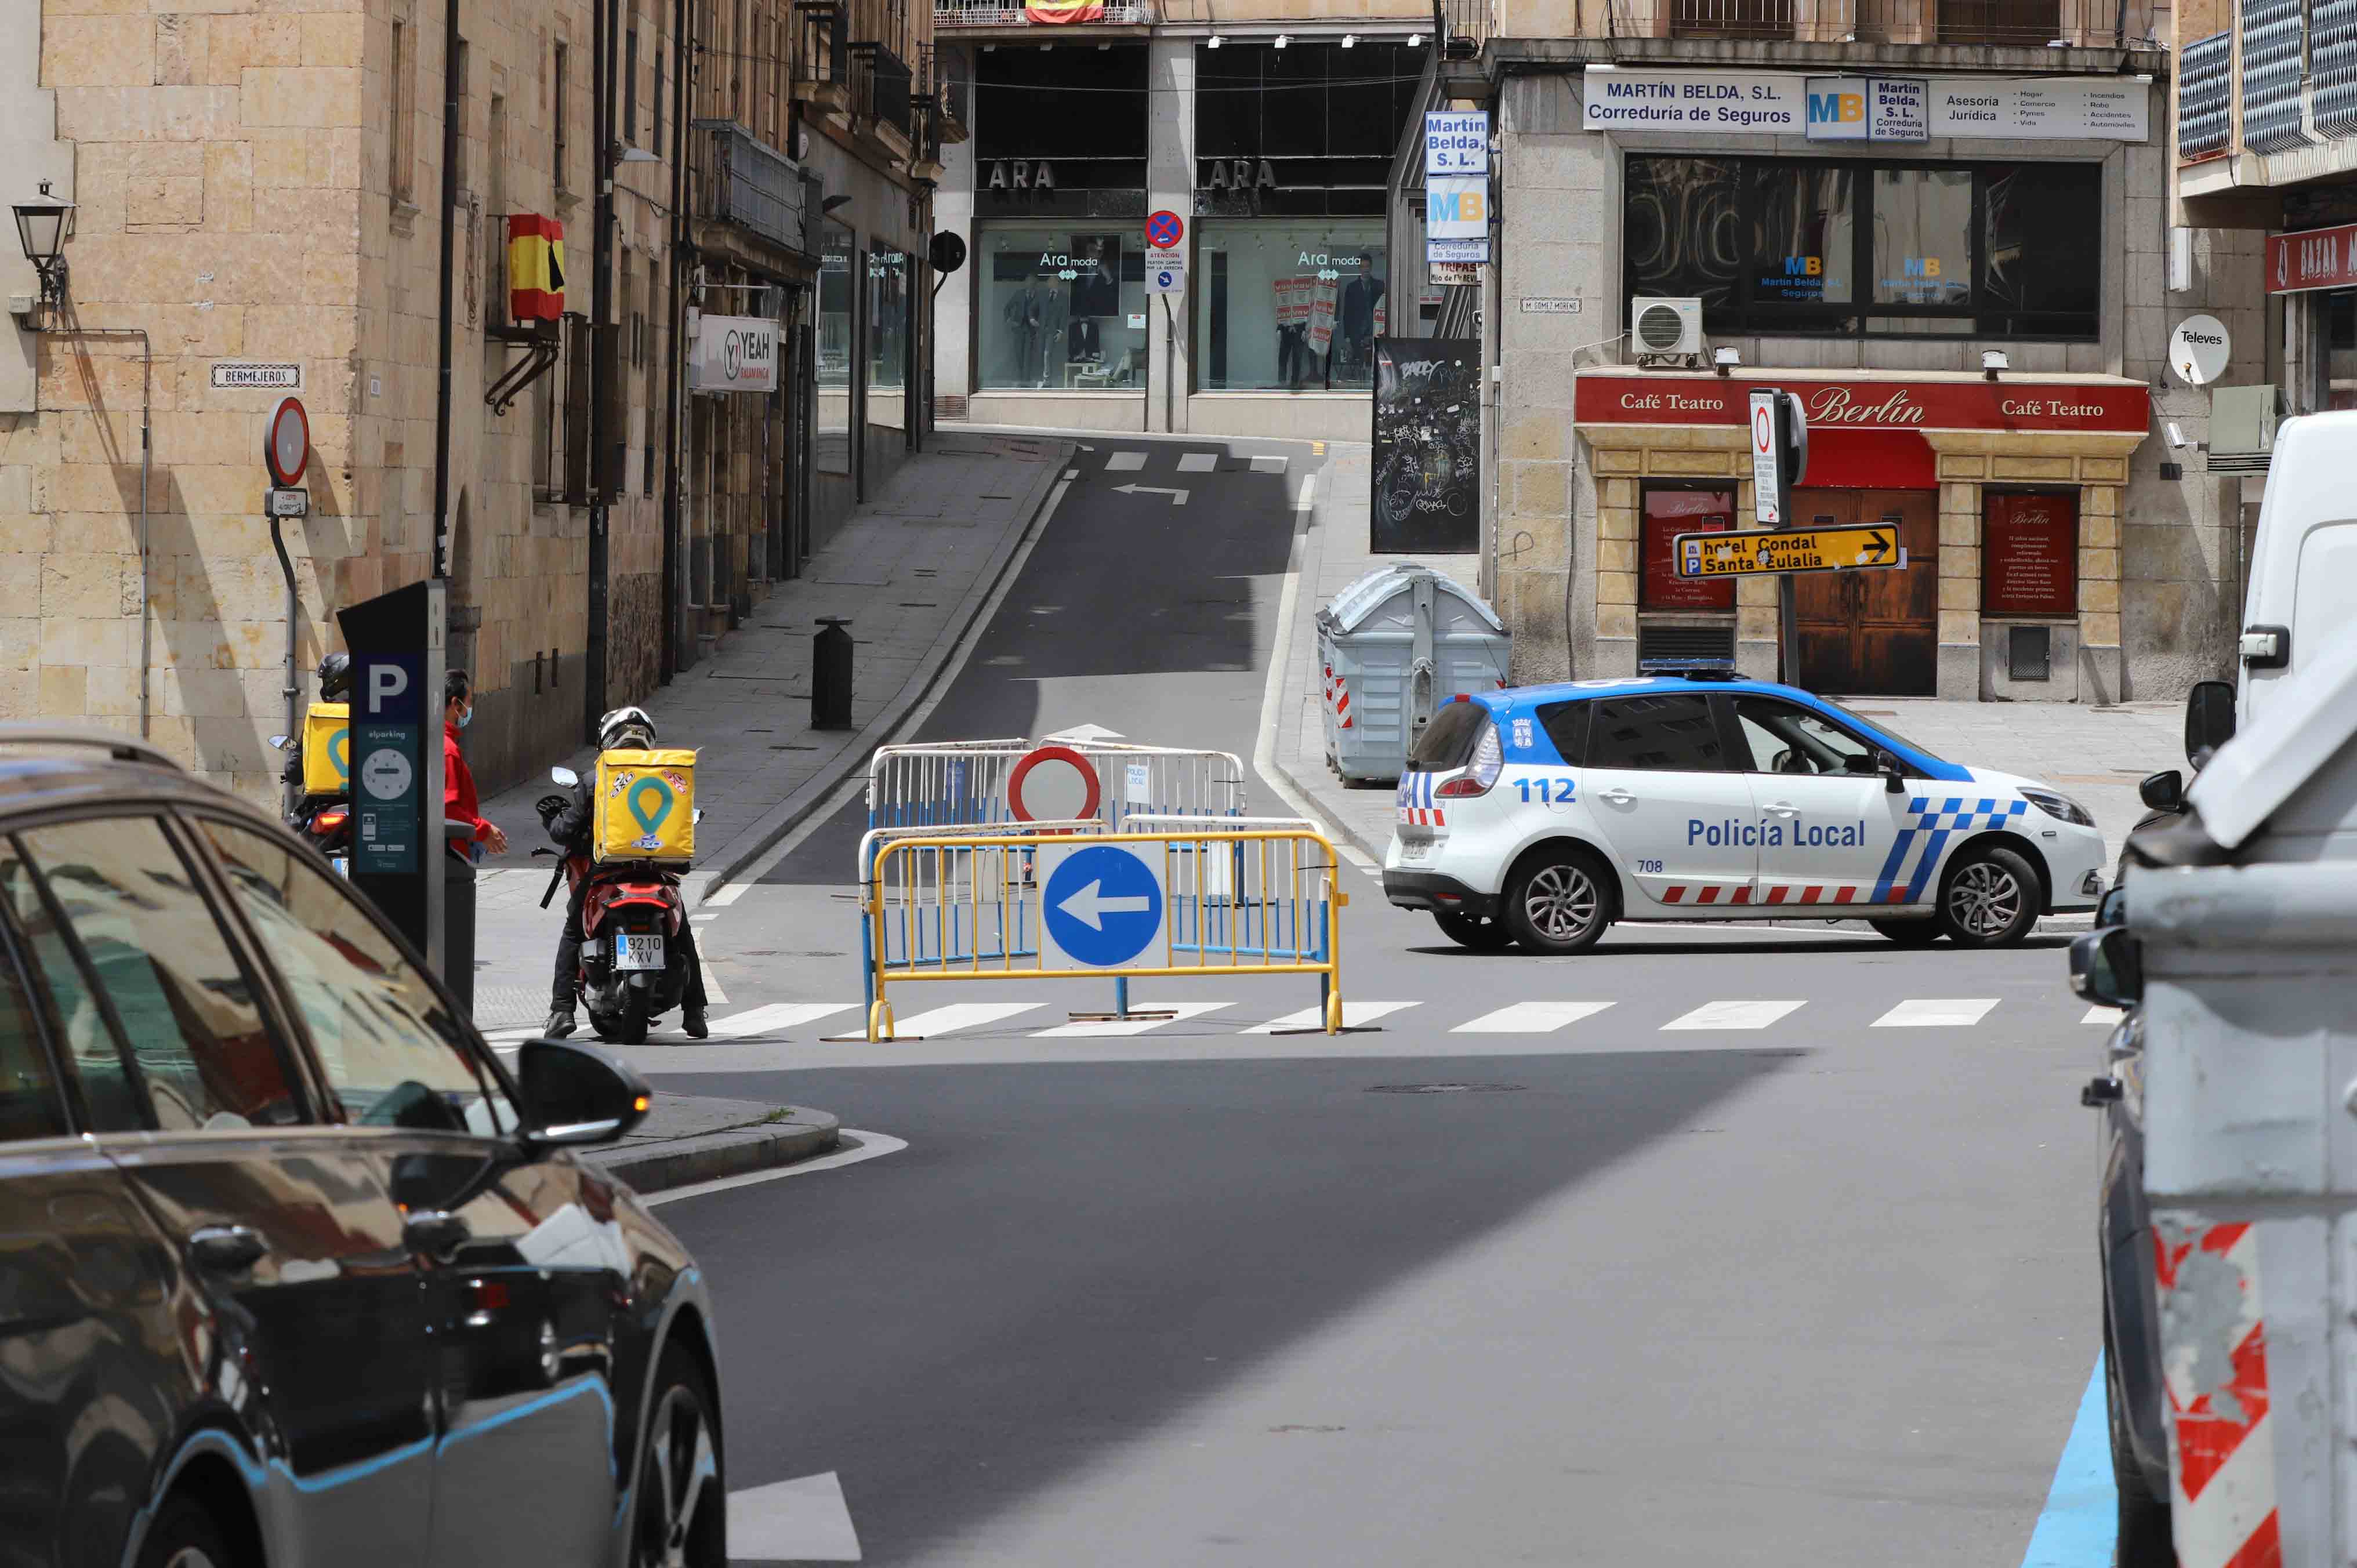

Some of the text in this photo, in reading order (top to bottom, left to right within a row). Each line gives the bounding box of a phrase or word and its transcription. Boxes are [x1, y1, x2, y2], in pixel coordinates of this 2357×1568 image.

[1607, 81, 1781, 102] MARTÍN BELDA, S.L.
[1878, 82, 1920, 94] Martín
[1808, 93, 1864, 123] MB
[1879, 95, 1920, 108] Belda,
[1946, 95, 1999, 107] Asesoría
[1589, 104, 1791, 125] Correduría de Seguros
[1885, 107, 1914, 118] S. L.
[1949, 110, 1997, 121] Jurídica
[1428, 118, 1486, 132] Martín
[1876, 119, 1923, 128] Correduría
[1888, 128, 1924, 138] Seguros
[1428, 136, 1485, 151] Belda,
[1437, 153, 1475, 166] S. L.
[988, 162, 1055, 188] ARA
[1209, 160, 1276, 188] ARA
[1430, 193, 1484, 222] MB
[1039, 252, 1098, 266] Ara moda
[1297, 251, 1361, 266] Ara moda
[1445, 251, 1481, 259] Seguros
[2301, 237, 2338, 280] BAZAR
[1785, 256, 1822, 275] MB
[1904, 257, 1940, 278] MB
[1554, 302, 1577, 310] MORENO
[2181, 331, 2222, 344] Televes
[741, 332, 770, 360] YEAH
[226, 371, 287, 382] BERMEJEROS
[1620, 393, 1724, 411] Café Teatro
[2001, 400, 2104, 416] Café Teatro
[1758, 535, 1816, 551] Condal
[1706, 557, 1754, 572] Santa
[369, 664, 408, 713] P
[368, 729, 406, 740] elparking
[1512, 778, 1576, 803] 112
[1688, 819, 1865, 847] Policía Local
[1637, 860, 1663, 873] 708
[628, 938, 661, 950] 9210
[629, 951, 652, 963] KXV
